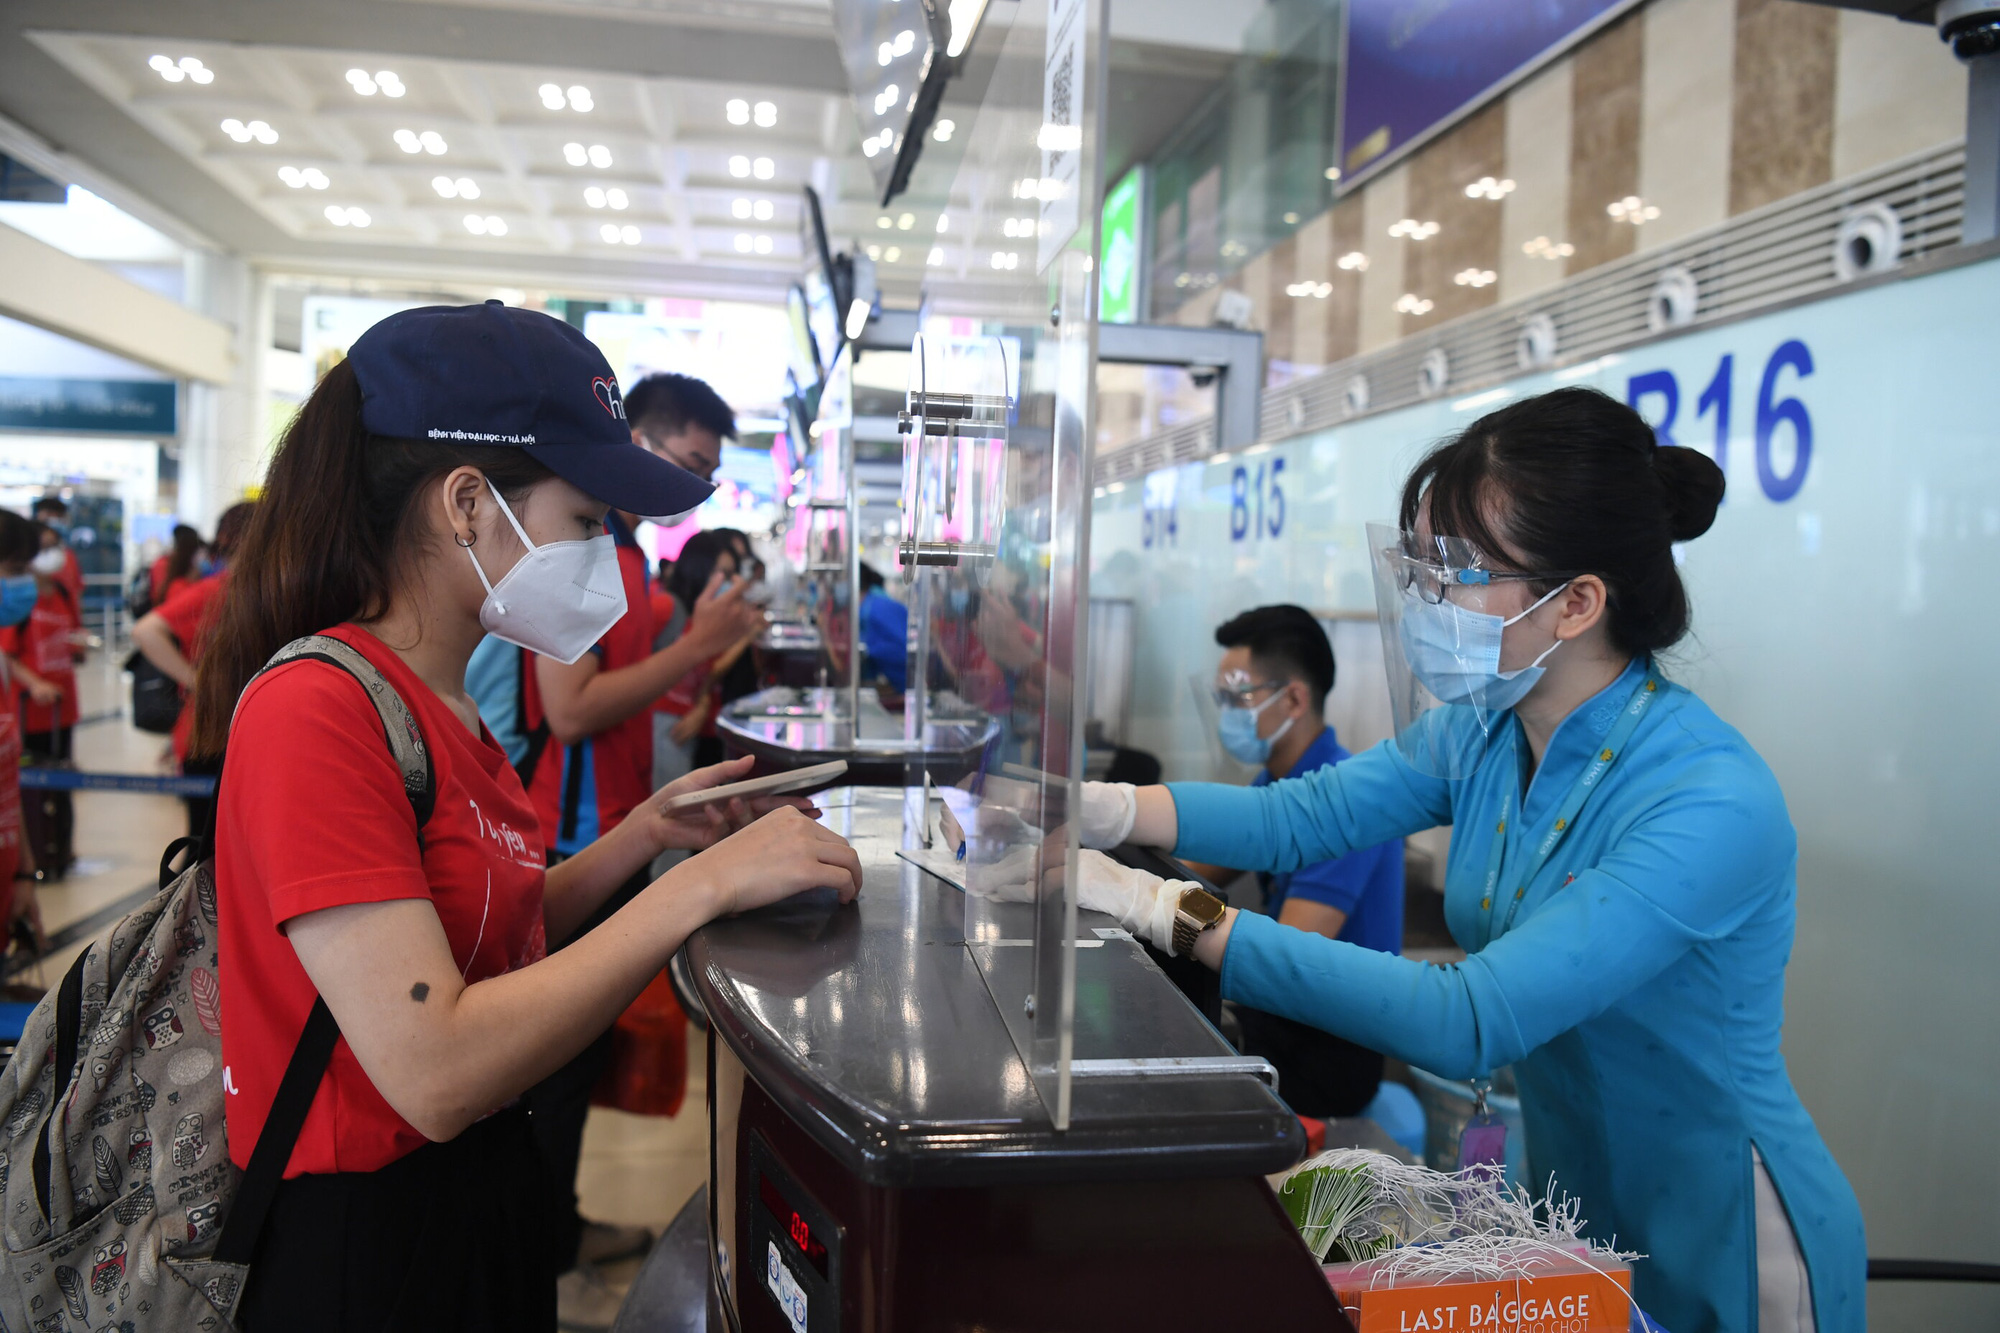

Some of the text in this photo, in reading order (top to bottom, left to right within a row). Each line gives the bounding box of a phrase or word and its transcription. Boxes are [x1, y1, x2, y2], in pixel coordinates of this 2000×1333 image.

[428, 428, 448, 440] BỆNH
[449, 429, 467, 441] VIỆN
[483, 433, 500, 443] HỌC
[1231, 458, 1286, 541] B15
[1400, 1294, 1589, 1332] LAST BAGGAGE
